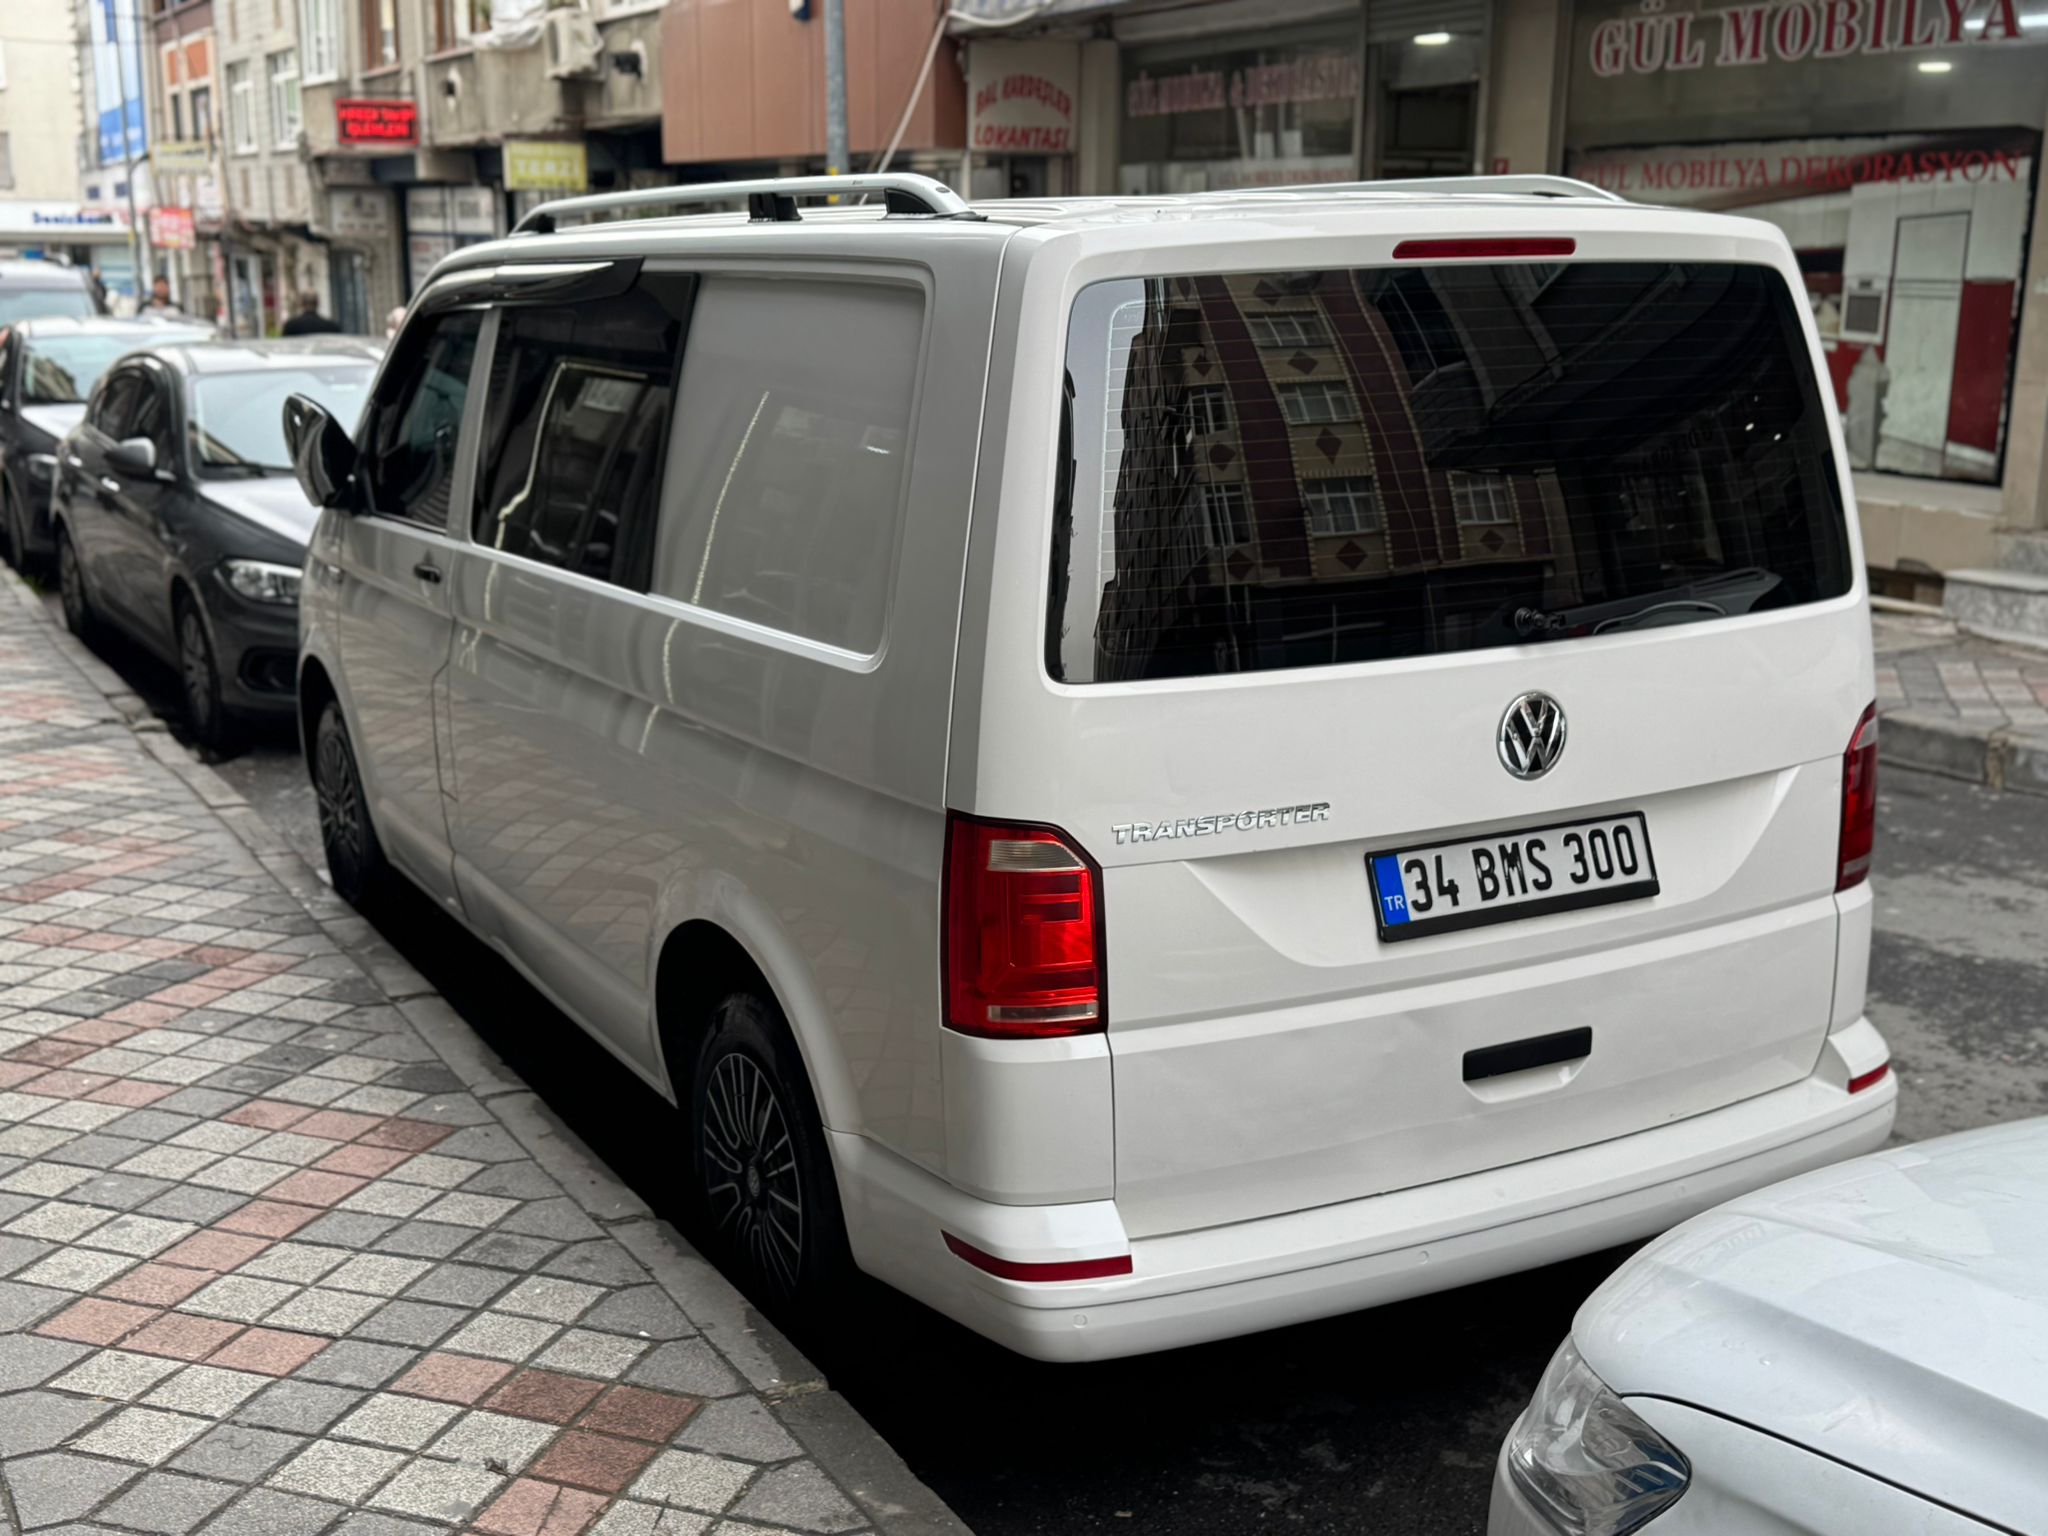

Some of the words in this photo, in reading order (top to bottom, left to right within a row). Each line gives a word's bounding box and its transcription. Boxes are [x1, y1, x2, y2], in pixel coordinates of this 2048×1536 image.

[1591, 0, 1704, 76] GÜL
[1639, 154, 1772, 191] MOBİLYA
[1779, 150, 2024, 189] DEKORASYON
[1112, 802, 1330, 845] TRANSPORTER
[1404, 854, 1460, 912] 34
[1472, 838, 1553, 901] BMS
[1563, 824, 1638, 884] 300
[1384, 895, 1405, 911] TR
